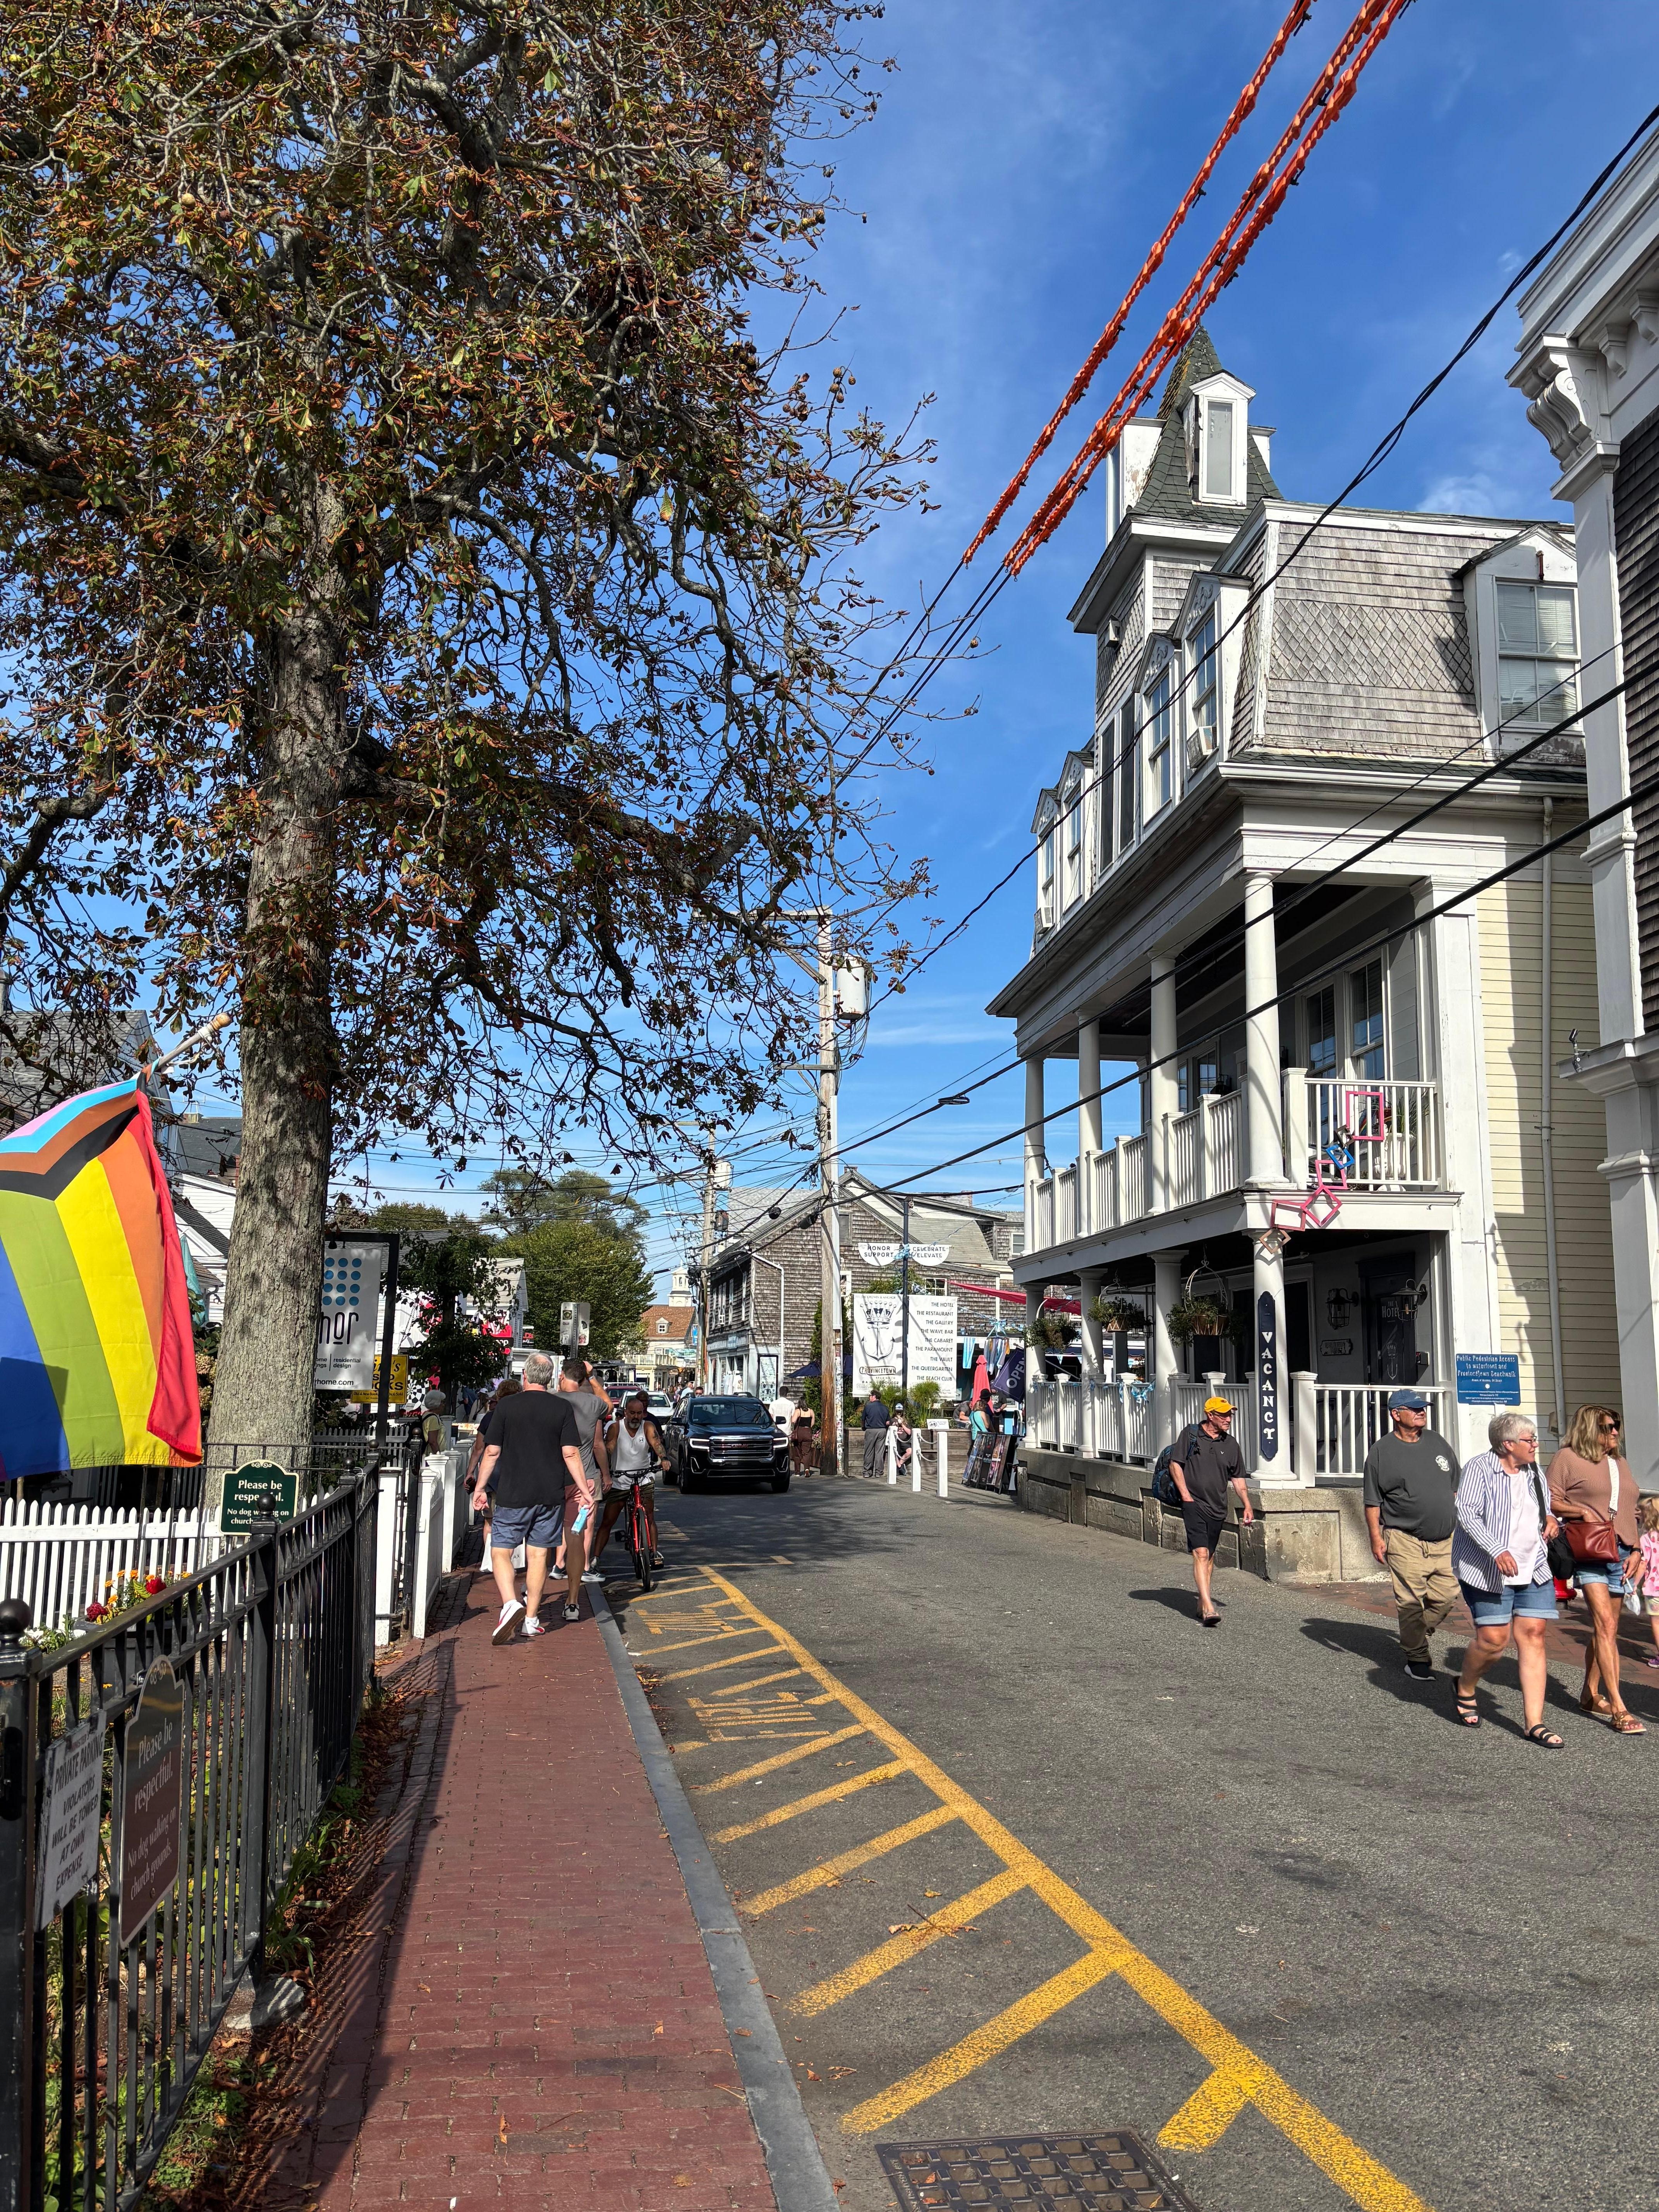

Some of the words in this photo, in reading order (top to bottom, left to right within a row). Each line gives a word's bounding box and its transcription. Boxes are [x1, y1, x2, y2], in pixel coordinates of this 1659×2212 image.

[1261, 1331, 1276, 1439] VACANCY
[238, 1479, 268, 1489] Please
[270, 1480, 283, 1490] be
[239, 1508, 252, 1517] dog
[54, 1751, 80, 1795] PRIVATE
[79, 1731, 104, 1775] PARKING
[138, 1731, 162, 1769] Please
[164, 1717, 173, 1745] be
[63, 1774, 96, 1816] VIOLATORS
[134, 1751, 173, 1814] respectful.
[52, 1823, 68, 1849] WILL
[69, 1816, 77, 1834] BE
[77, 1793, 98, 1826] TOWED
[59, 1844, 69, 1865] AT
[70, 1827, 86, 1855] OWN
[128, 1847, 137, 1872] No
[138, 1837, 149, 1860] dog
[149, 1814, 169, 1847] walking
[169, 1806, 176, 1823] on
[55, 1852, 84, 1892] EXPENSE
[131, 1862, 150, 1901] church
[150, 1838, 172, 1884] grounds.
